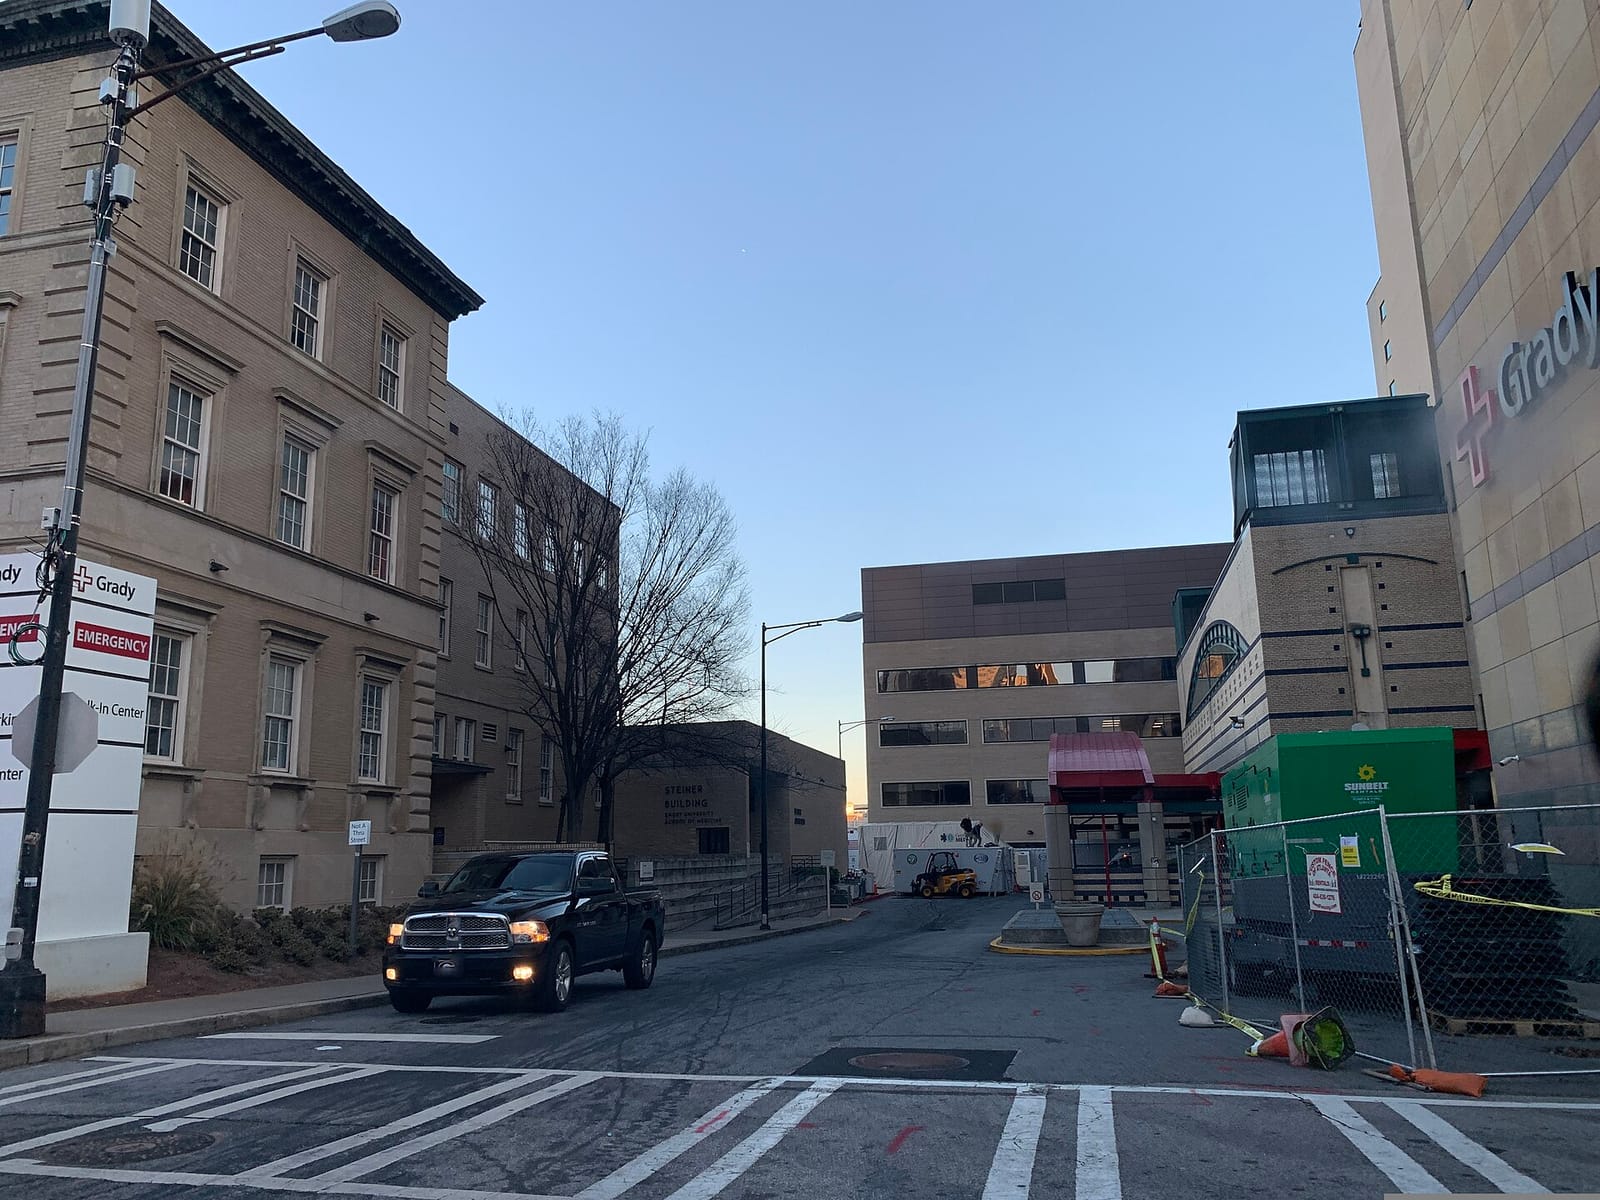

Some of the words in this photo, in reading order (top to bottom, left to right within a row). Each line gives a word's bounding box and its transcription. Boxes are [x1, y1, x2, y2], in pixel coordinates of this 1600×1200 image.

[1498, 266, 1600, 419] Grady
[96, 575, 136, 602] Grady
[76, 628, 148, 654] EMERGENCY
[111, 703, 144, 719] Center
[664, 784, 704, 795] STEINER
[1344, 782, 1389, 790] SUNBELT
[664, 798, 709, 809] BUILDING
